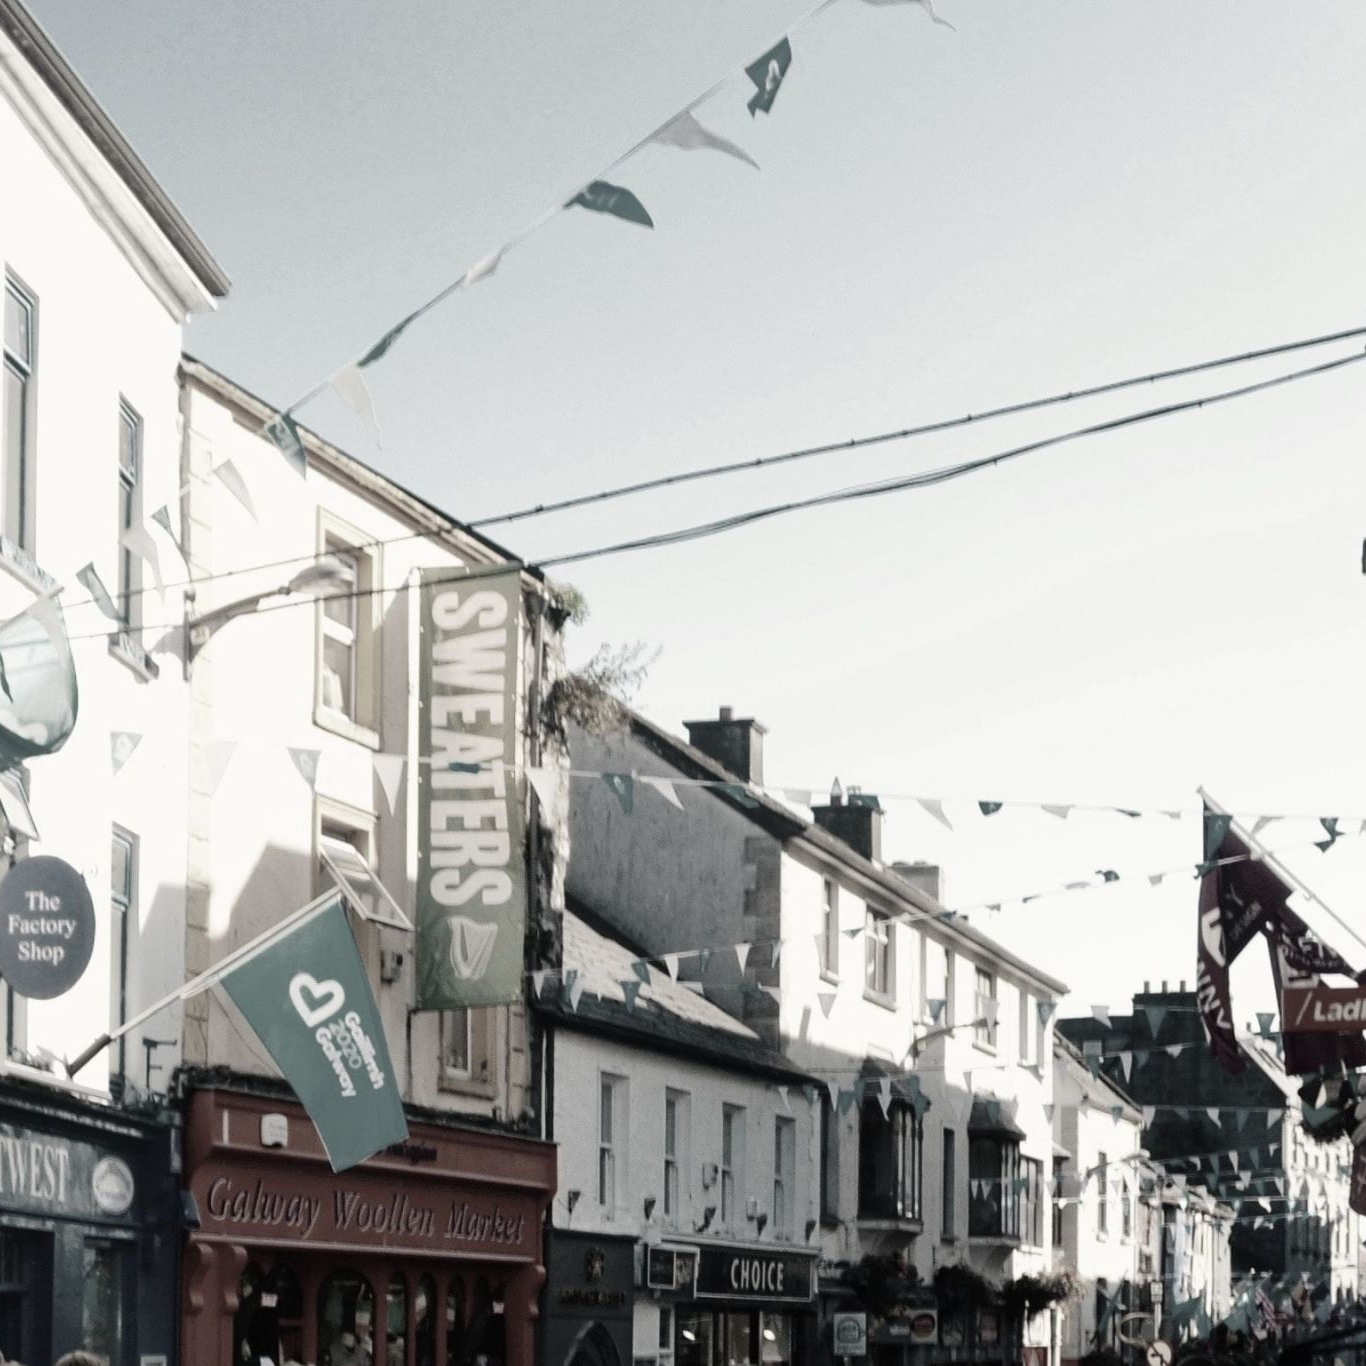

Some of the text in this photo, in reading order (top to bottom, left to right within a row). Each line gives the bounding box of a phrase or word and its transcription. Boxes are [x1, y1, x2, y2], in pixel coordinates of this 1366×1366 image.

[431, 590, 513, 906] SWEATERS
[24, 890, 61, 912] The
[6, 913, 78, 940] Factory
[17, 942, 65, 966] Shop
[315, 1027, 357, 1097] Galway
[328, 1019, 362, 1069] 2020
[209, 1177, 527, 1245] Galway Woollen Market
[730, 1257, 785, 1292] CHOICE
